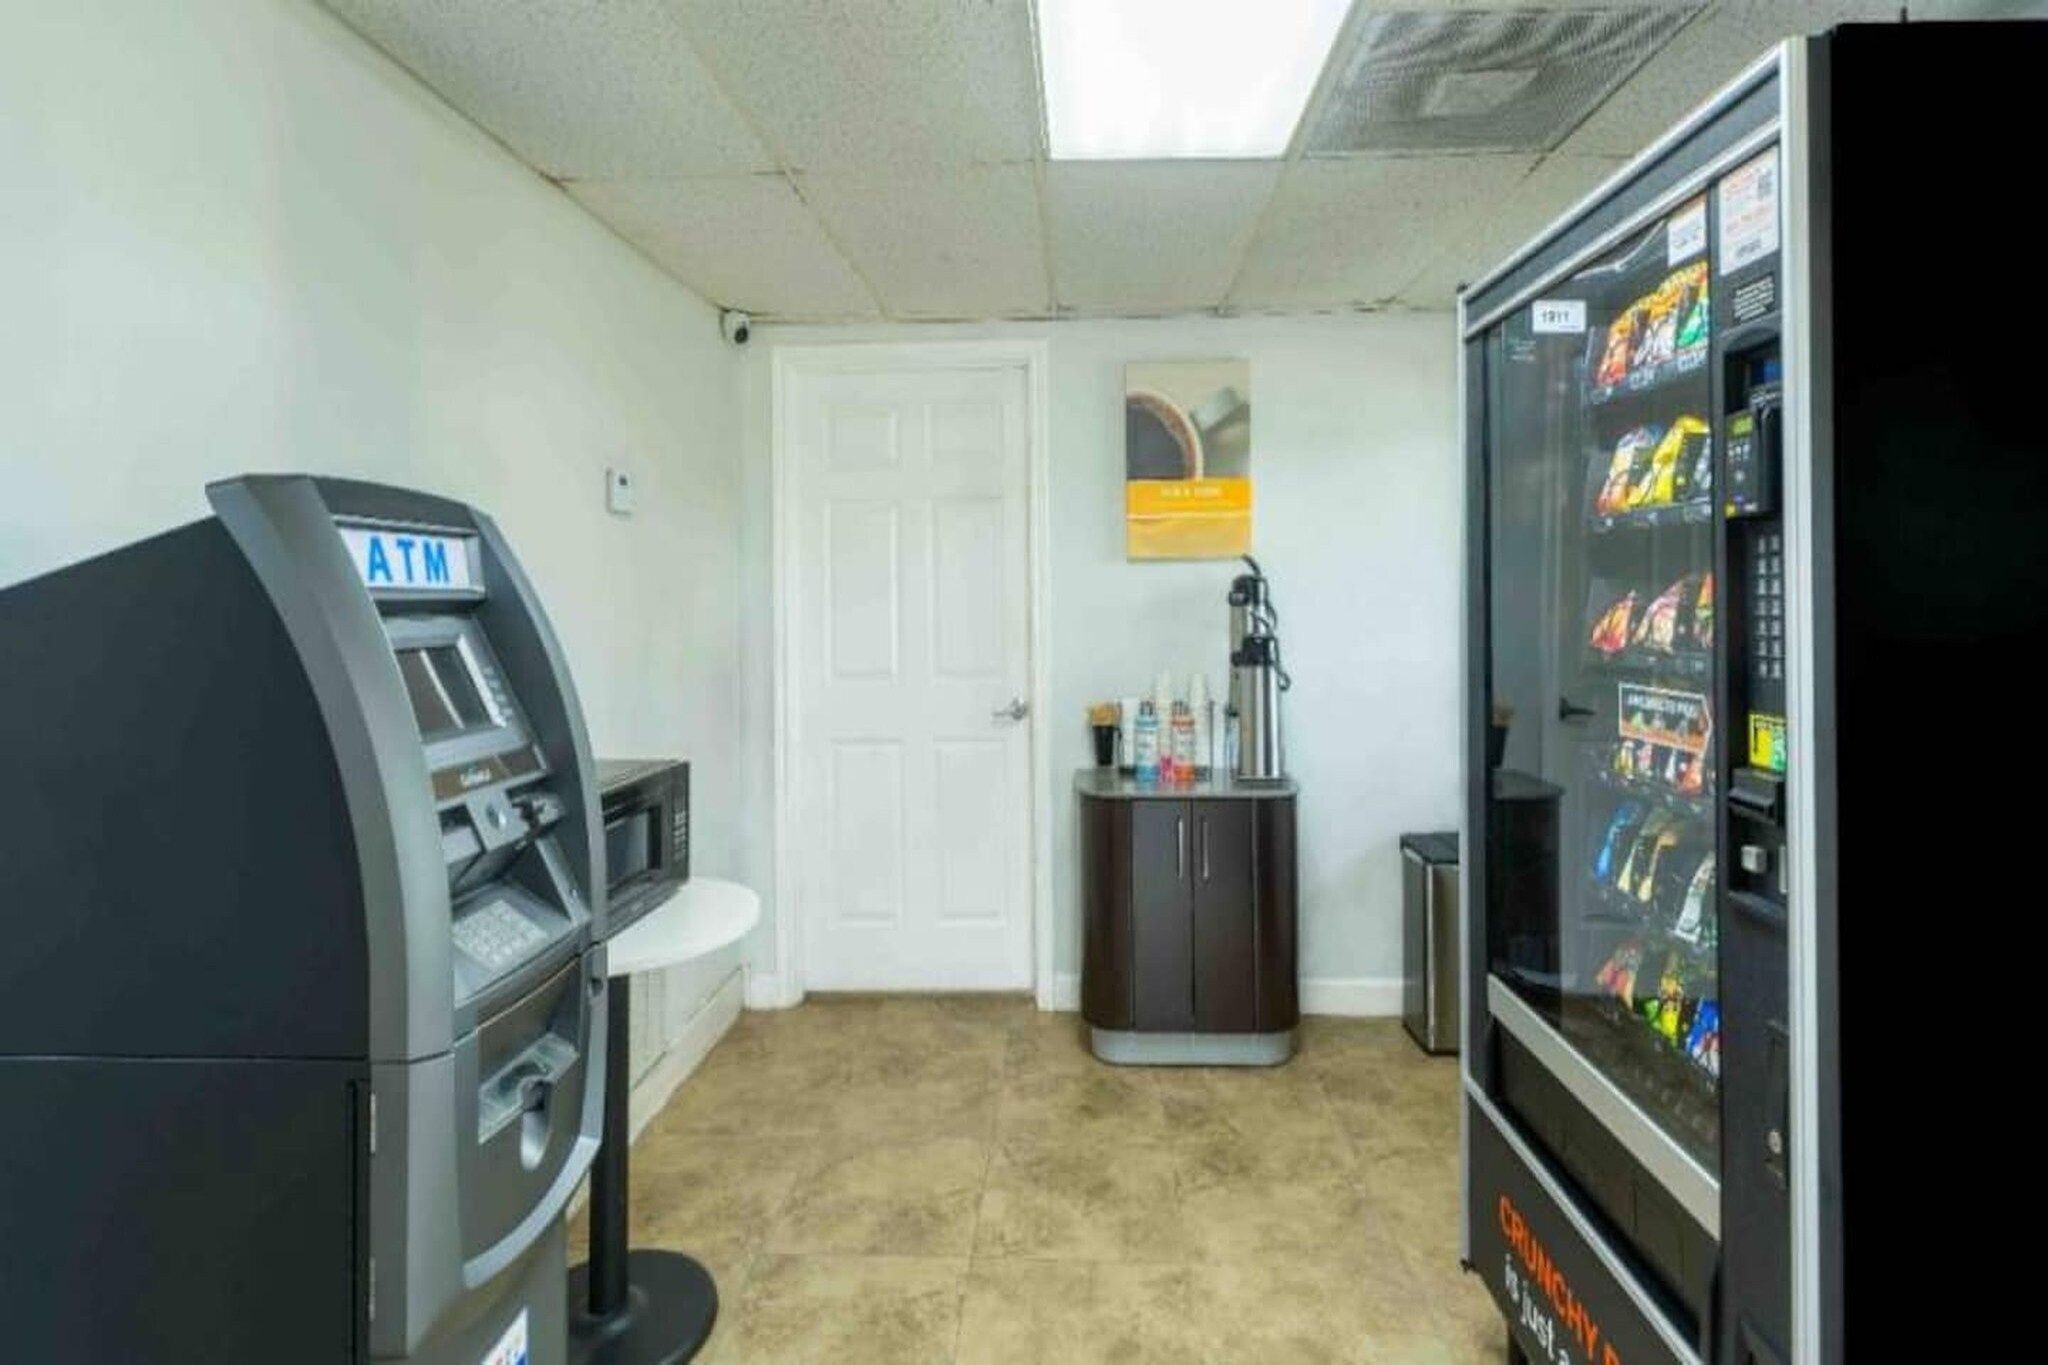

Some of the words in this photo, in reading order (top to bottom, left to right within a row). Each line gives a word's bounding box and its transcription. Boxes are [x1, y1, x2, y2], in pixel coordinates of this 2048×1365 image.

[367, 535, 450, 583] ATM
[1499, 1194, 1599, 1361] CRUNCHY
[1505, 1253, 1519, 1303] is
[1519, 1280, 1556, 1361] just
